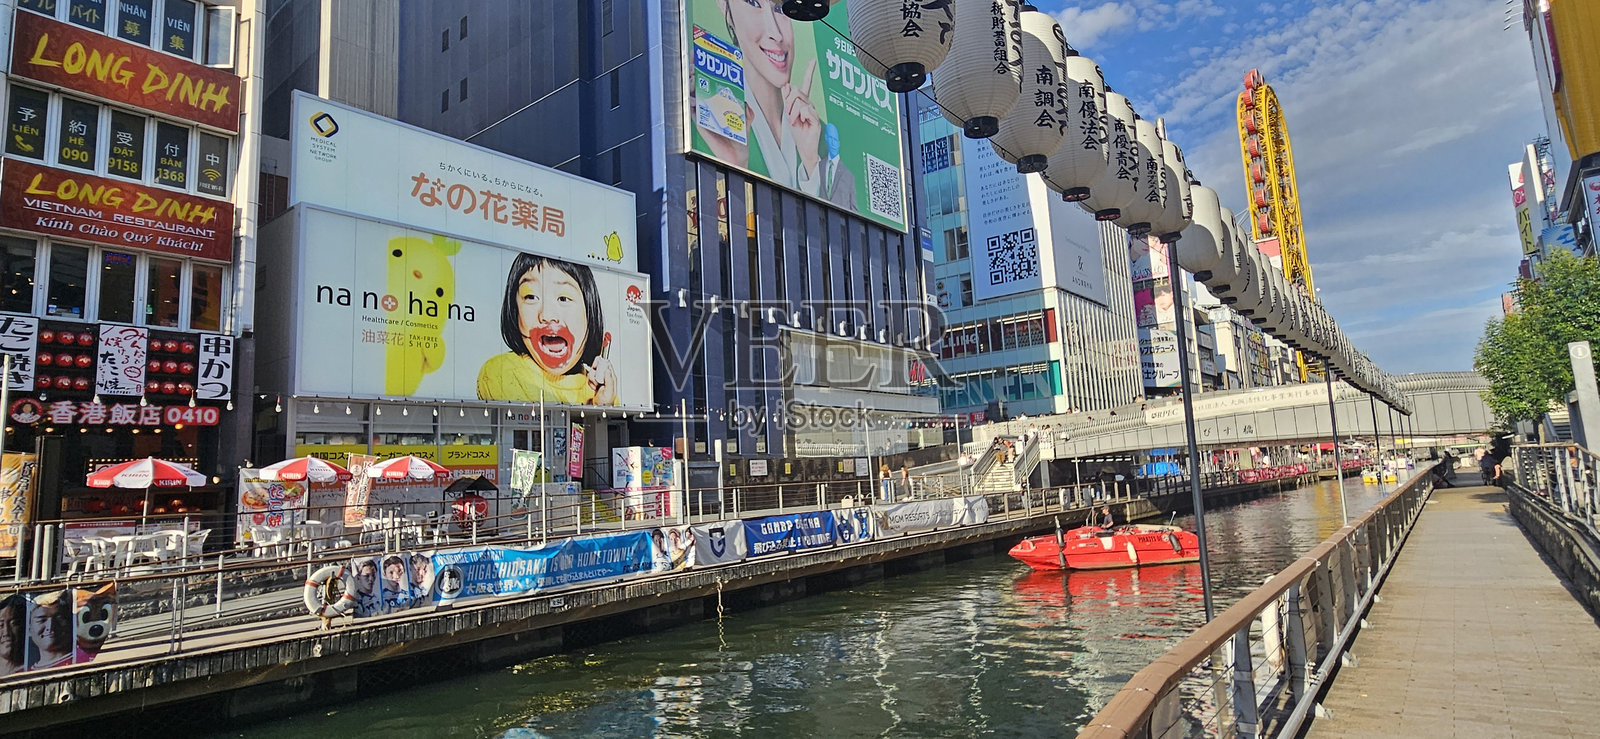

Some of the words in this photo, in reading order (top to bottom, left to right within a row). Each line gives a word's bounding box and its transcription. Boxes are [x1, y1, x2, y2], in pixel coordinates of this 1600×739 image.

[72, 5, 100, 24] バイト
[124, 20, 141, 37] 募
[170, 35, 186, 51] 集
[119, 1, 147, 19] NHÂN
[167, 17, 190, 33] VIÊN
[900, 0, 923, 38] 協会
[28, 33, 136, 88] LONG
[142, 63, 231, 113] DINH
[696, 48, 743, 88] サロンパス
[826, 49, 894, 114] サロンパス
[1033, 64, 1056, 128] 南調会
[12, 123, 39, 136] LIÊN
[69, 136, 84, 147] HỆ
[161, 157, 182, 168] BÀN
[17, 106, 37, 122] 予
[69, 120, 87, 136] 約
[116, 131, 133, 146] 受
[164, 143, 180, 158] 付
[205, 153, 220, 165] 中
[62, 148, 89, 163] 090
[108, 157, 138, 174] 9158
[157, 168, 185, 183] 1368
[25, 173, 124, 209] LONG
[131, 191, 215, 224] DINH
[410, 172, 566, 238] なの花薬局
[24, 197, 102, 219] VIETNAM
[113, 214, 215, 238] RESTAURANT
[35, 216, 74, 231] Kính
[79, 222, 118, 239] Chào
[123, 228, 153, 245] Quý
[156, 235, 203, 251] Khách!
[316, 284, 351, 307] na
[409, 291, 438, 318] ha
[448, 301, 476, 323] na
[361, 315, 400, 325] Healthcare
[405, 320, 439, 330] Cosmetics
[361, 329, 405, 347] 油菜花
[409, 334, 438, 342] TAX-FREE
[408, 341, 438, 349] SHOP
[201, 337, 231, 399] 串かつ
[48, 401, 163, 425] 香港飯店
[167, 408, 217, 423] 0410
[447, 451, 490, 459] ブランドコスメ
[905, 511, 930, 522] RESORTS
[468, 557, 547, 581] HIGASHIOSAKA
[550, 556, 559, 573] IS
[577, 547, 634, 567] HOMETOWN!!
[470, 552, 478, 562] TO
